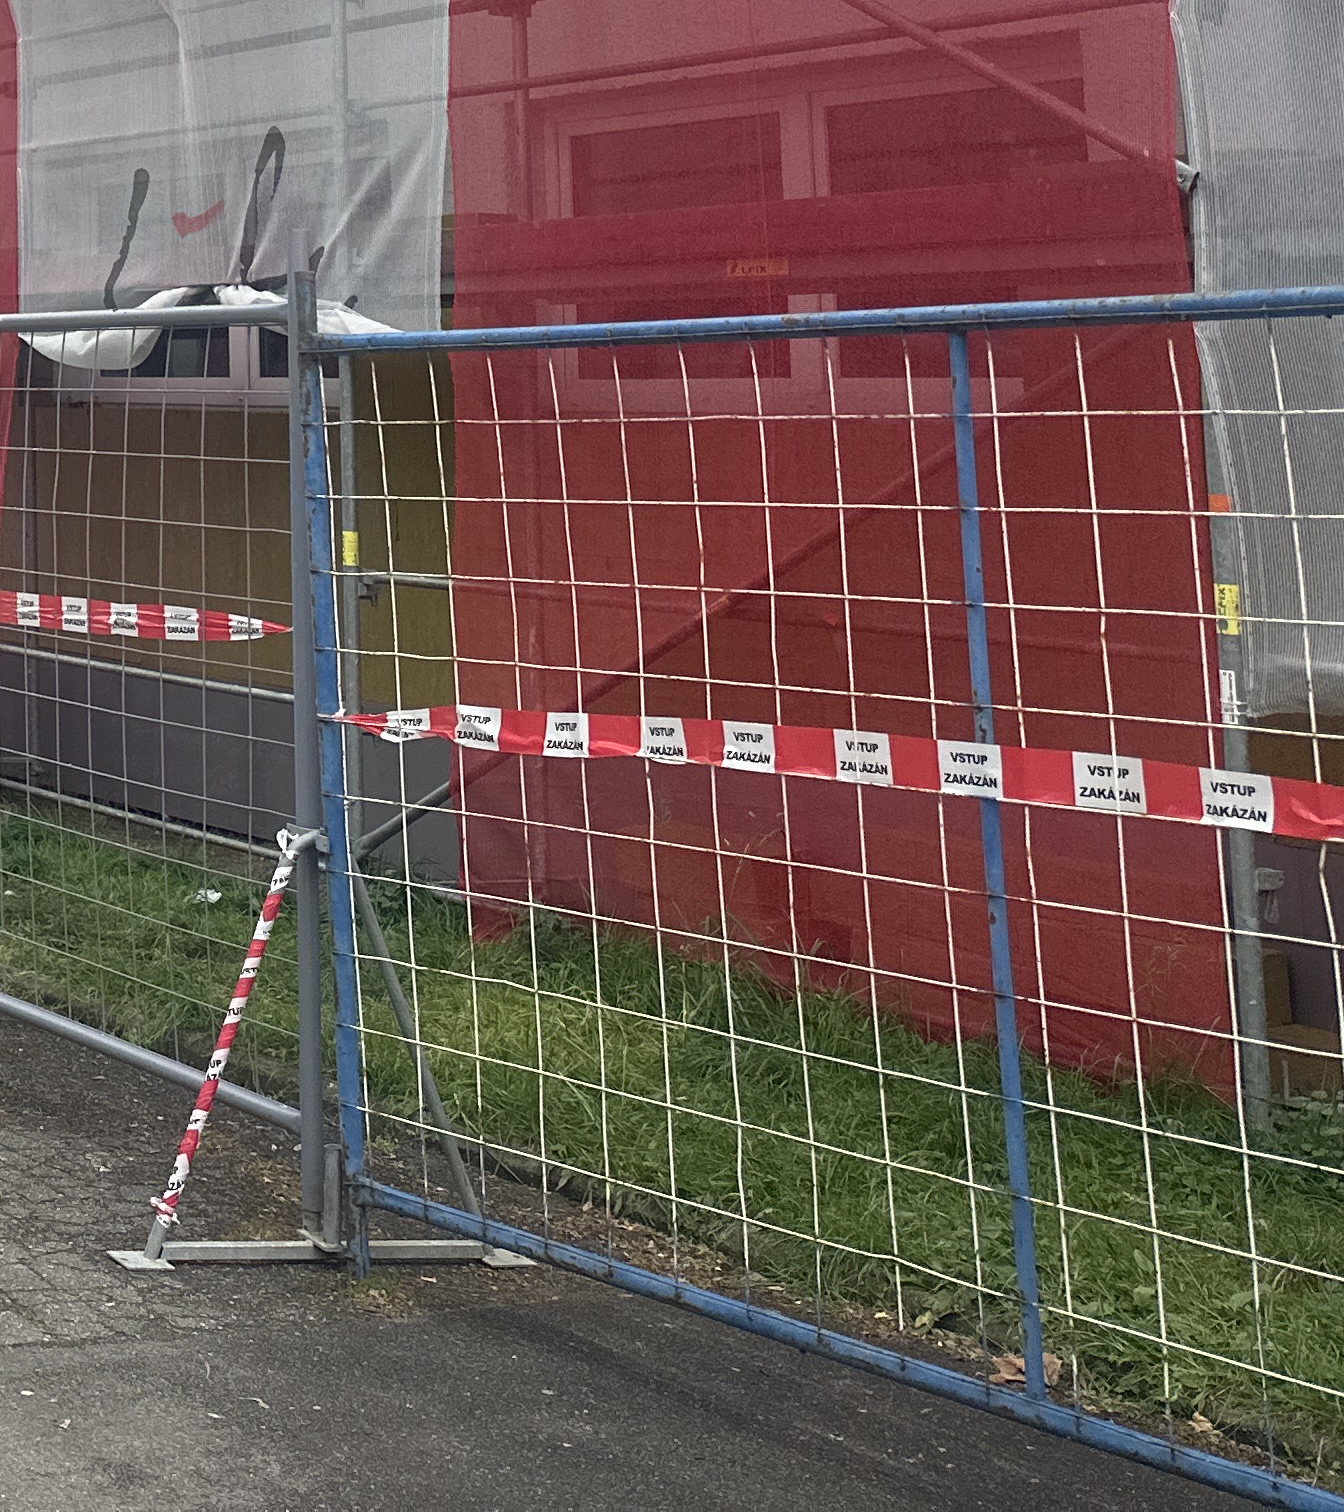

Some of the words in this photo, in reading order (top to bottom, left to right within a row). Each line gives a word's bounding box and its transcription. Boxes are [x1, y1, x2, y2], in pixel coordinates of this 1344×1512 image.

[460, 714, 492, 725] VSTUP
[554, 722, 578, 732] VSTUP
[649, 726, 675, 737] VSTUP
[732, 731, 763, 744] VSTUP
[726, 749, 771, 765] ZAKÁZÁN
[950, 751, 988, 765] VSTUP
[943, 771, 998, 789] ZAKÁZÁN
[1210, 780, 1256, 797] VSTUP
[1205, 802, 1267, 823] ZAKÁZÁN
